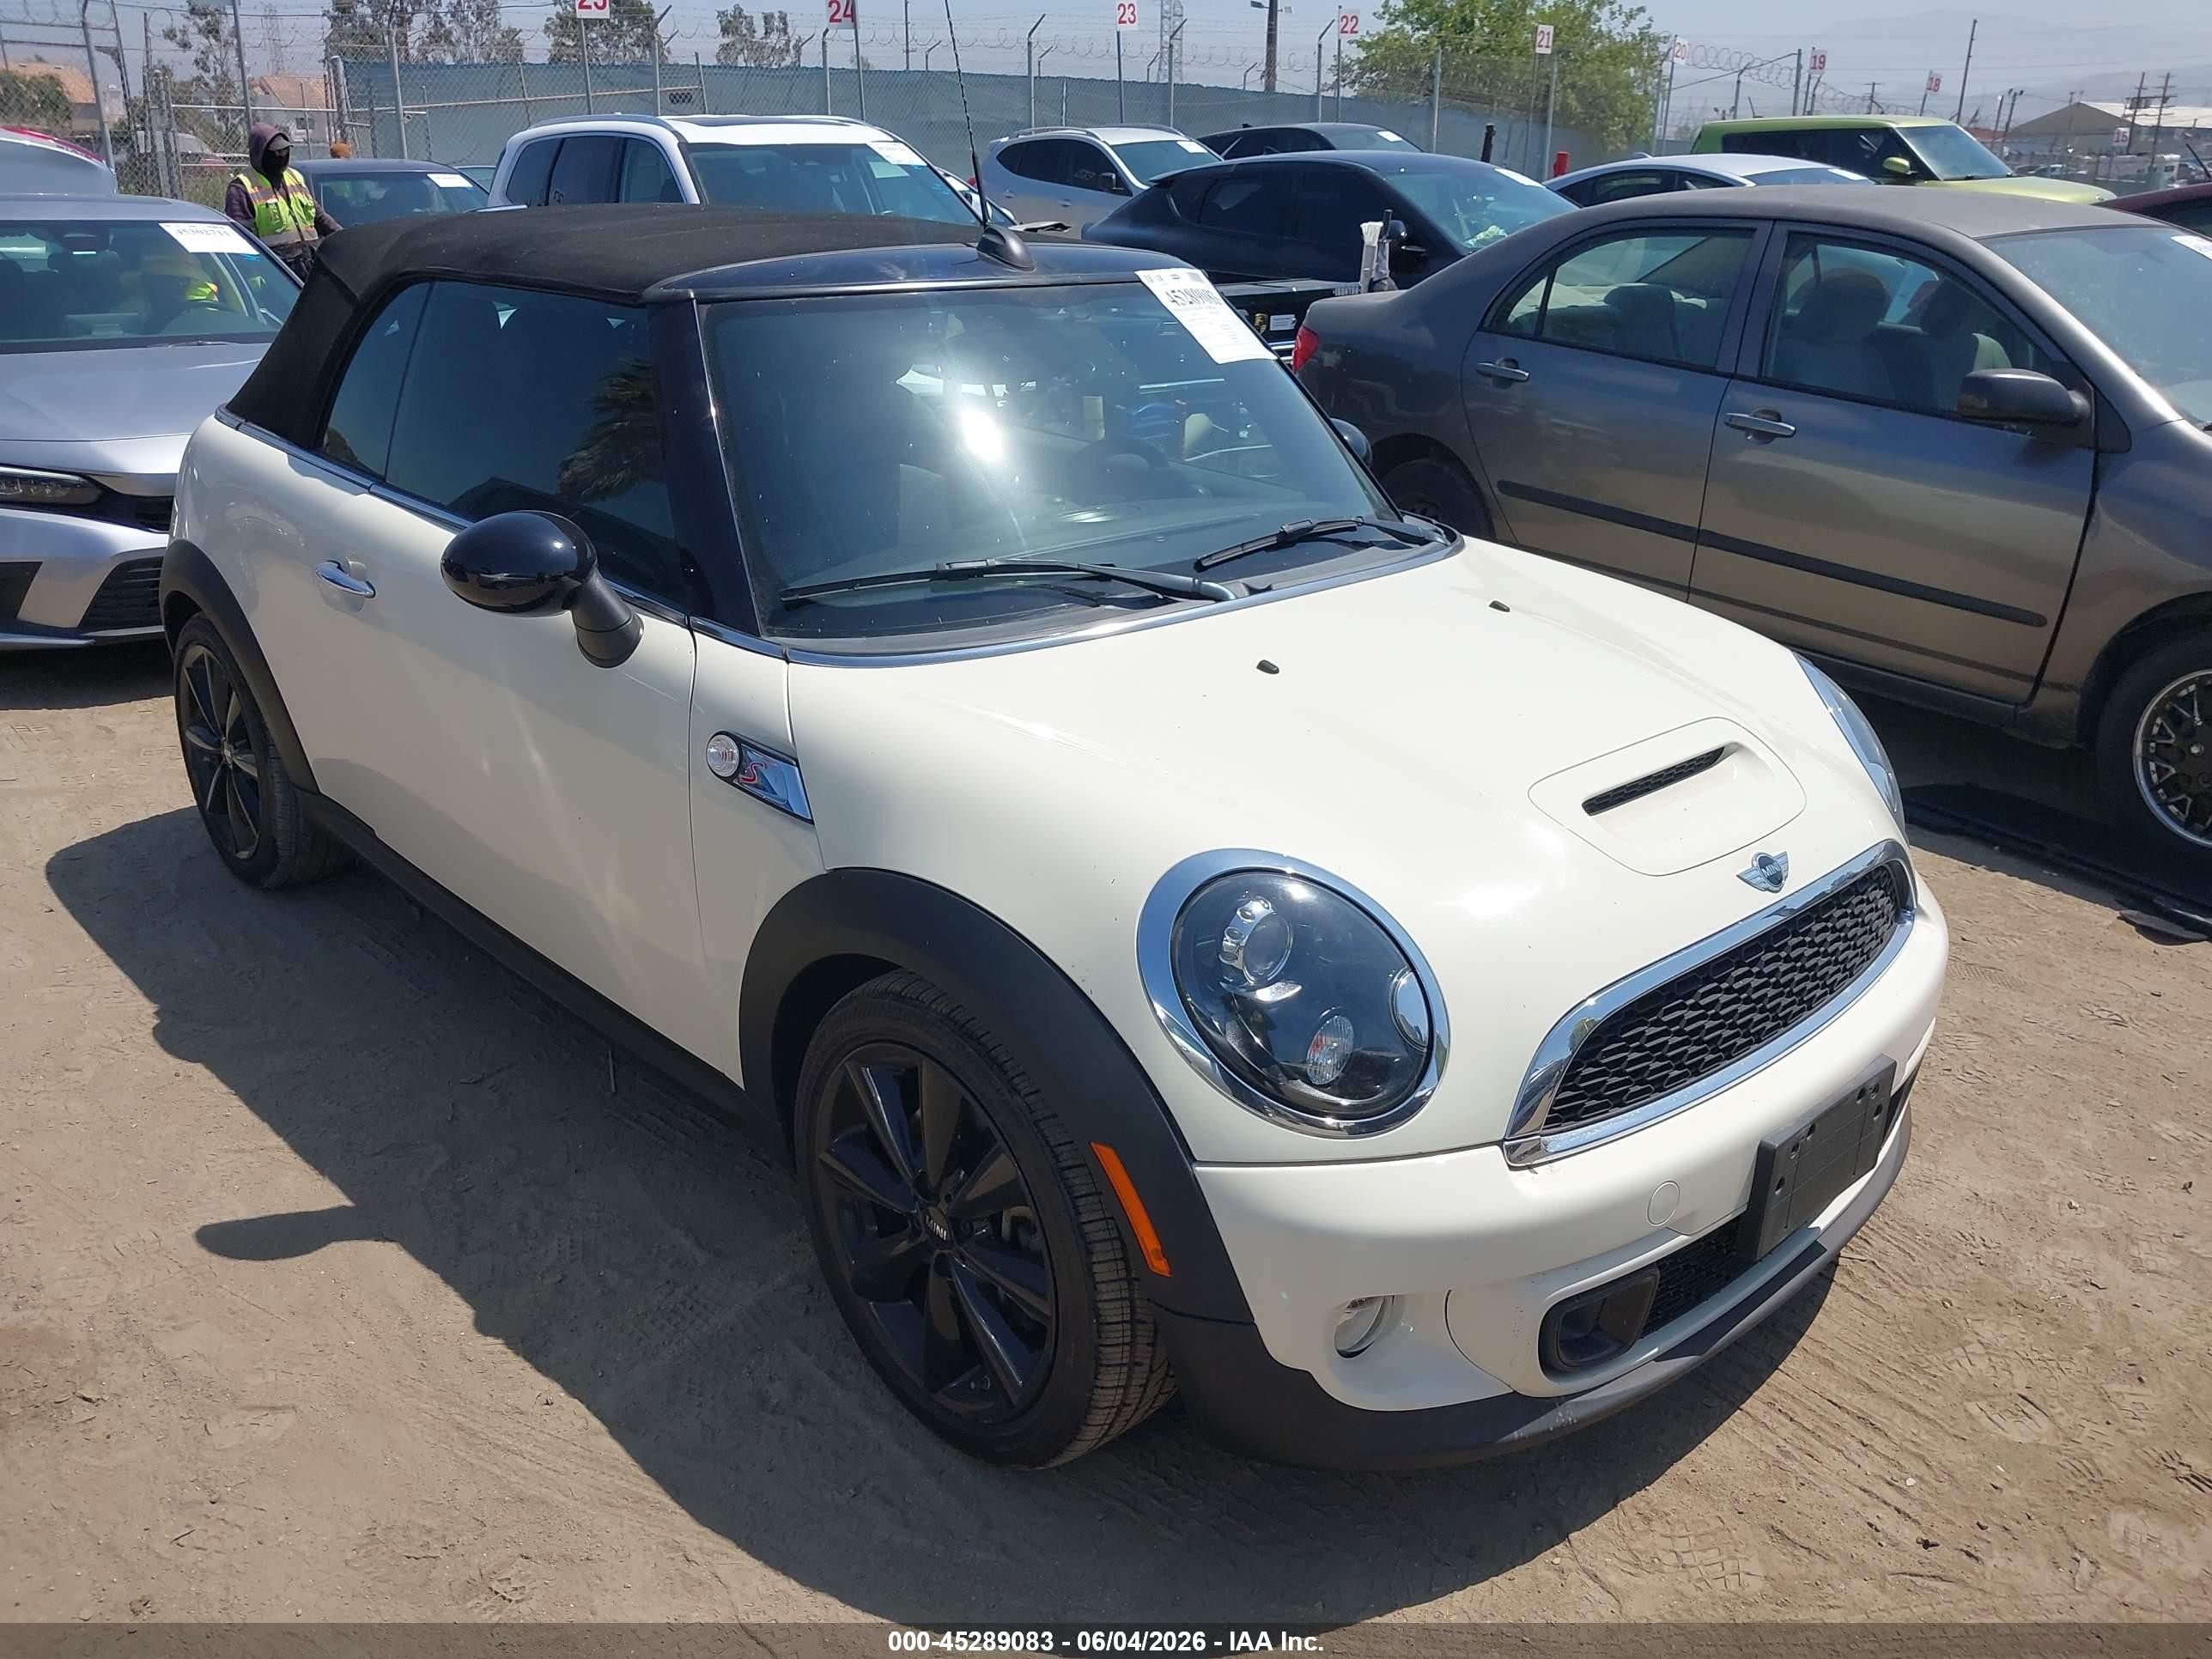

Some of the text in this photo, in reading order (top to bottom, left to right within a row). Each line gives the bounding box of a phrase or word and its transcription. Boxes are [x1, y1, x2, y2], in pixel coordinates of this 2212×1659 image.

[828, 0, 854, 23] 24
[1117, 3, 1136, 24] 23
[1340, 15, 1358, 33] 22
[1538, 30, 1551, 48] 21
[1674, 42, 1687, 59] 20
[1811, 54, 1826, 70] 19
[1926, 77, 1941, 92] 18
[2113, 131, 2128, 143] 15
[1761, 862, 1781, 878] MINI
[925, 1214, 947, 1241] MINI
